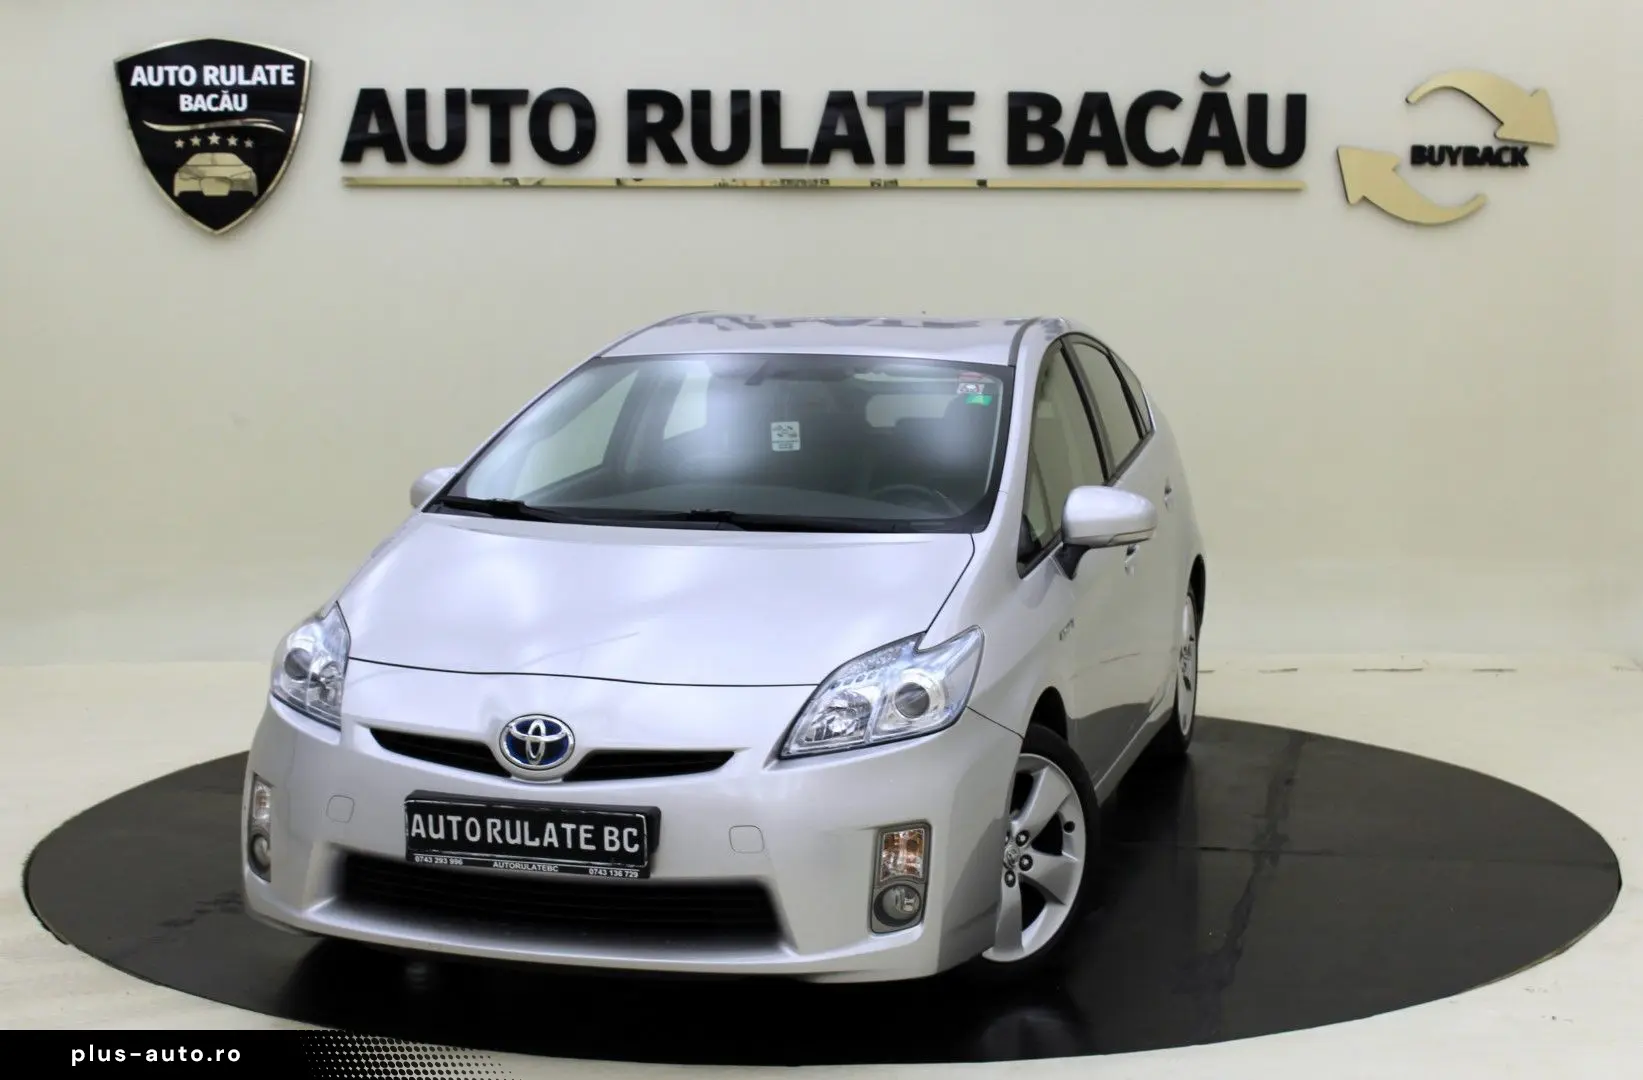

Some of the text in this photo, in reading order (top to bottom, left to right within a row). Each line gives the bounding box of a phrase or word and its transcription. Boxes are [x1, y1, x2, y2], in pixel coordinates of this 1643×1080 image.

[130, 64, 295, 87] AUTO RULATE
[179, 90, 248, 112] BACĂU
[340, 72, 1307, 169] AUTO RULATE BACĂU
[1410, 144, 1529, 167] BUYBACK
[603, 827, 640, 853] BC
[414, 855, 433, 863] 0743
[492, 861, 559, 873] AUTORULATEBC
[588, 868, 607, 876] 0743
